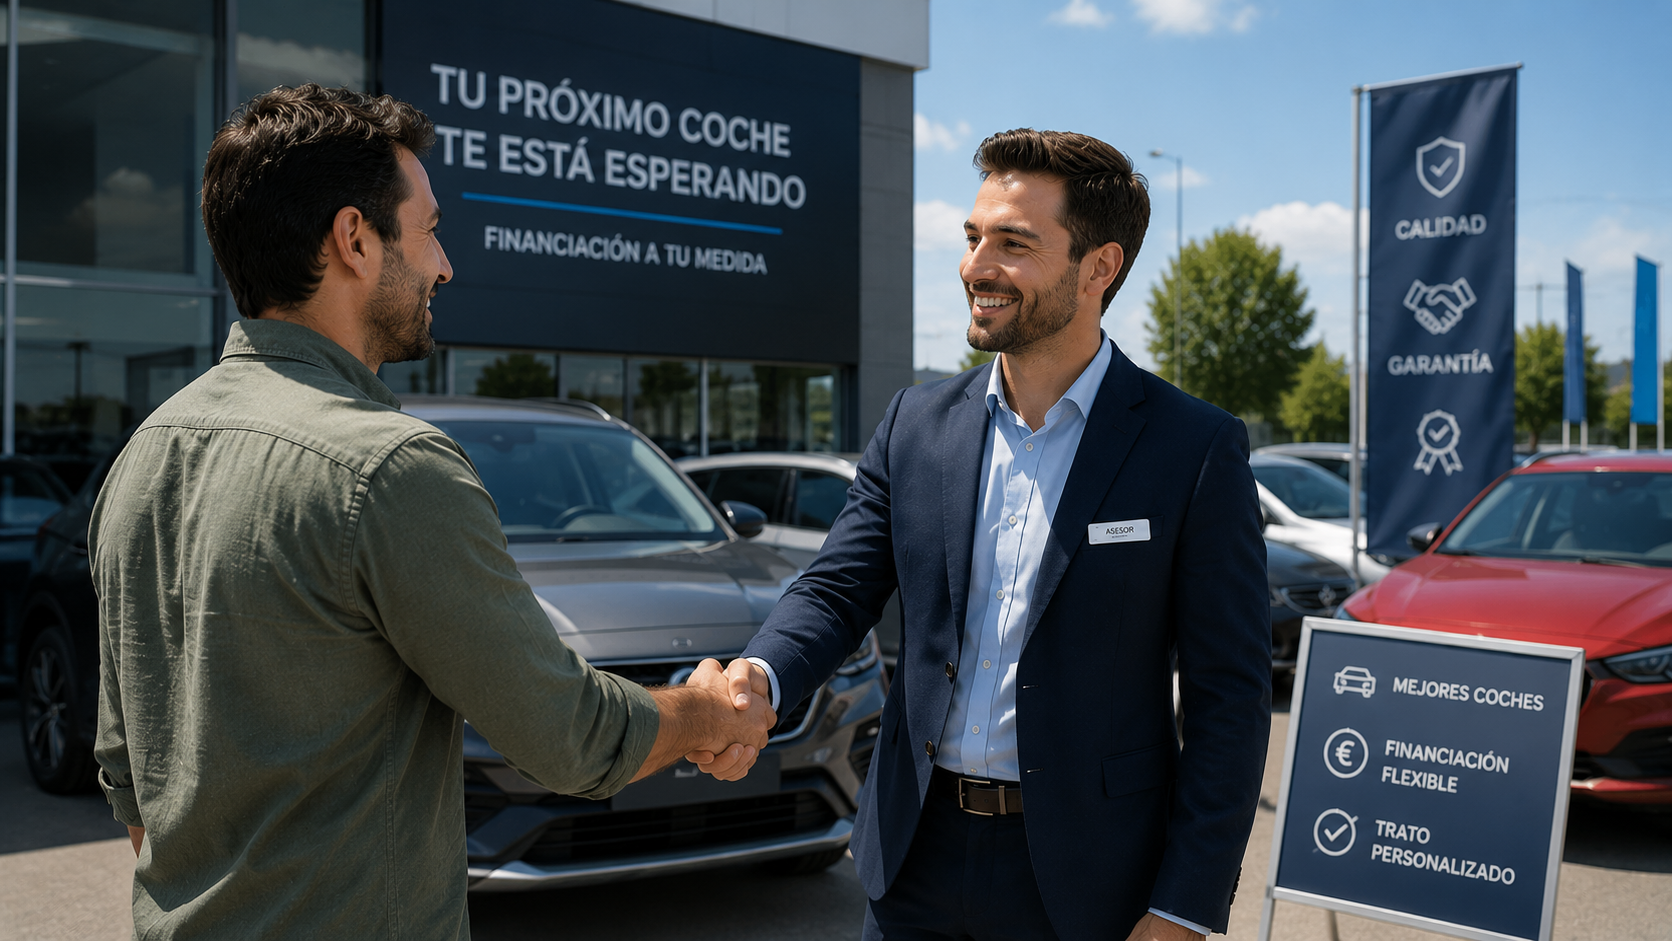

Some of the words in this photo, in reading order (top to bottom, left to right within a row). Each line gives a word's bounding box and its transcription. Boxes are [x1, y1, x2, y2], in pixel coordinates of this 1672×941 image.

[431, 63, 486, 109] TU
[499, 75, 670, 138] PRÓXIMO
[679, 107, 791, 158] COCHE
[435, 125, 487, 169] TE
[499, 134, 595, 183] ESTÁ
[605, 149, 806, 209] ESPERANDO
[1395, 213, 1487, 240] CALIDAD
[485, 226, 640, 263] FINANCIACIÓN
[644, 241, 660, 266] A
[664, 243, 691, 268] TU
[695, 247, 768, 275] MEDIDA
[1387, 348, 1494, 375] GARANTÍA
[1106, 526, 1134, 534] ASESOR
[1393, 677, 1469, 701] MEJORES
[1474, 687, 1544, 711] COCHES
[1385, 740, 1509, 773] FINANCIACIÓN
[1381, 766, 1458, 793] FLEXIBLE
[1375, 820, 1430, 844] TRATO
[1371, 844, 1515, 885] PERSONALIZADO
